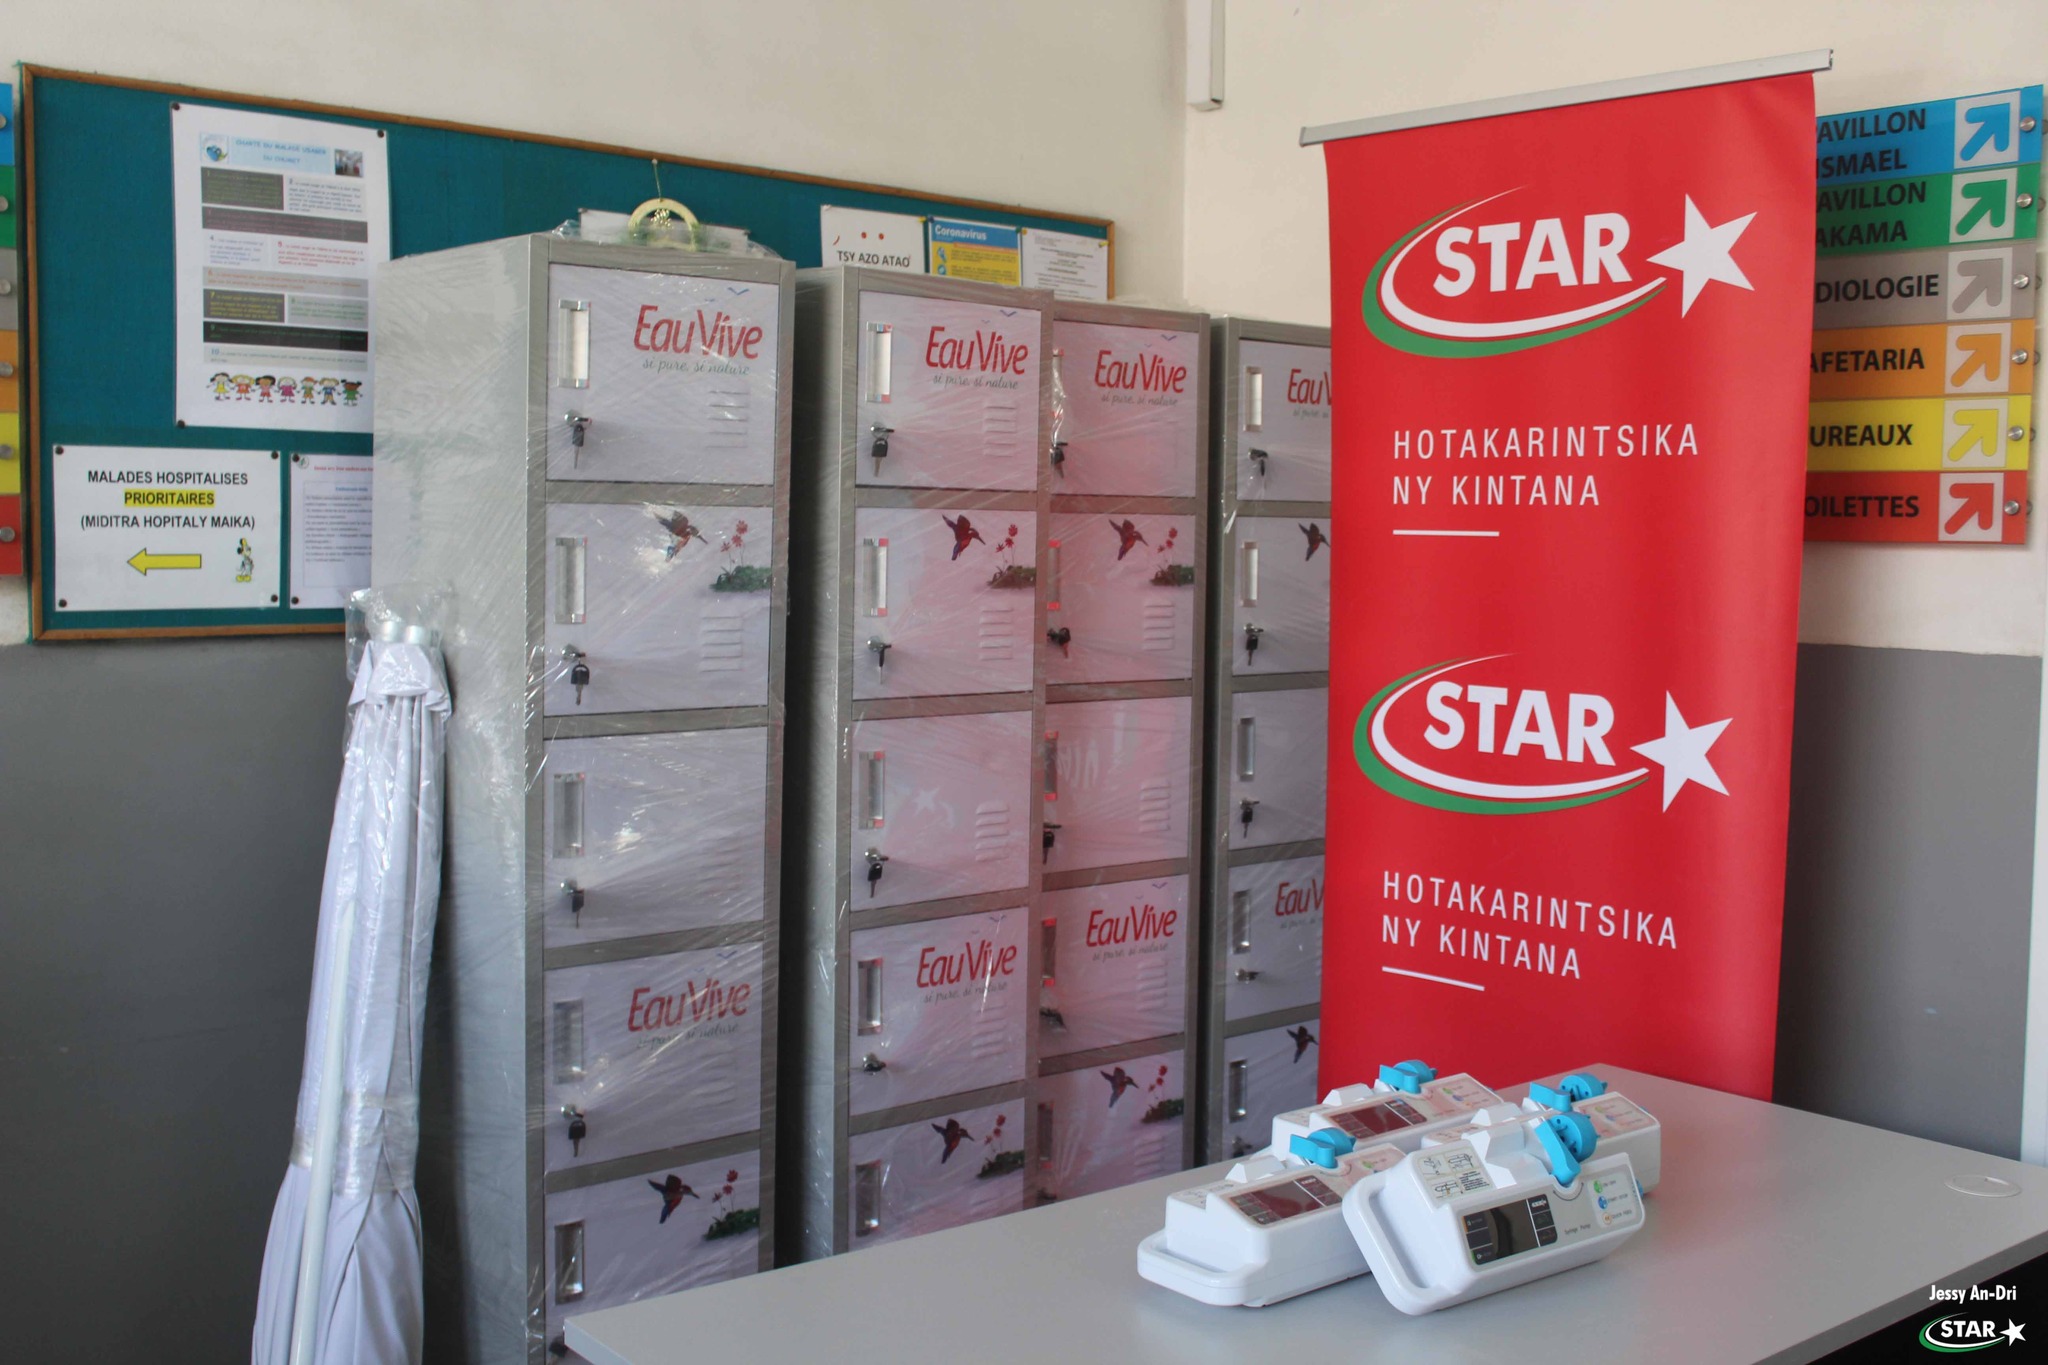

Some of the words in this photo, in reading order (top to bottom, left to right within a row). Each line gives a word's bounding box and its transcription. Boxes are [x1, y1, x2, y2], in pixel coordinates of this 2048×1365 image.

[1817, 108, 1926, 144] AVILLON
[1816, 182, 1926, 214] AVILLON
[934, 224, 987, 240] Coronavirus
[1816, 220, 1908, 248] AKAMA
[838, 250, 855, 262] TSY
[858, 253, 879, 264] AZO
[882, 256, 910, 268] ATAO
[1433, 212, 1632, 297] STAR
[1816, 274, 1939, 304] DIOLOGIE
[708, 361, 750, 376] nature
[1810, 348, 1925, 373] AFETARIA
[986, 376, 1018, 390] nature
[1394, 424, 1698, 460] HOTAKARINTSIKA
[1810, 424, 1913, 447] UREAUX
[88, 470, 152, 484] MALADES
[156, 472, 248, 486] HOSPITALISES
[1393, 476, 1432, 505] NY
[1452, 475, 1600, 506] KINTANA
[124, 492, 214, 506] PRIORITAIRES
[1804, 495, 1920, 518] OILETTES
[80, 514, 140, 531] (MIDITRA
[143, 515, 208, 528] HOPITALY
[211, 516, 255, 530] MAIKA)
[1424, 681, 1616, 766] STAR
[1383, 870, 1677, 949] HOTAKARINTSIKA
[1382, 915, 1420, 948] NY
[1440, 926, 1580, 979] KINTANA
